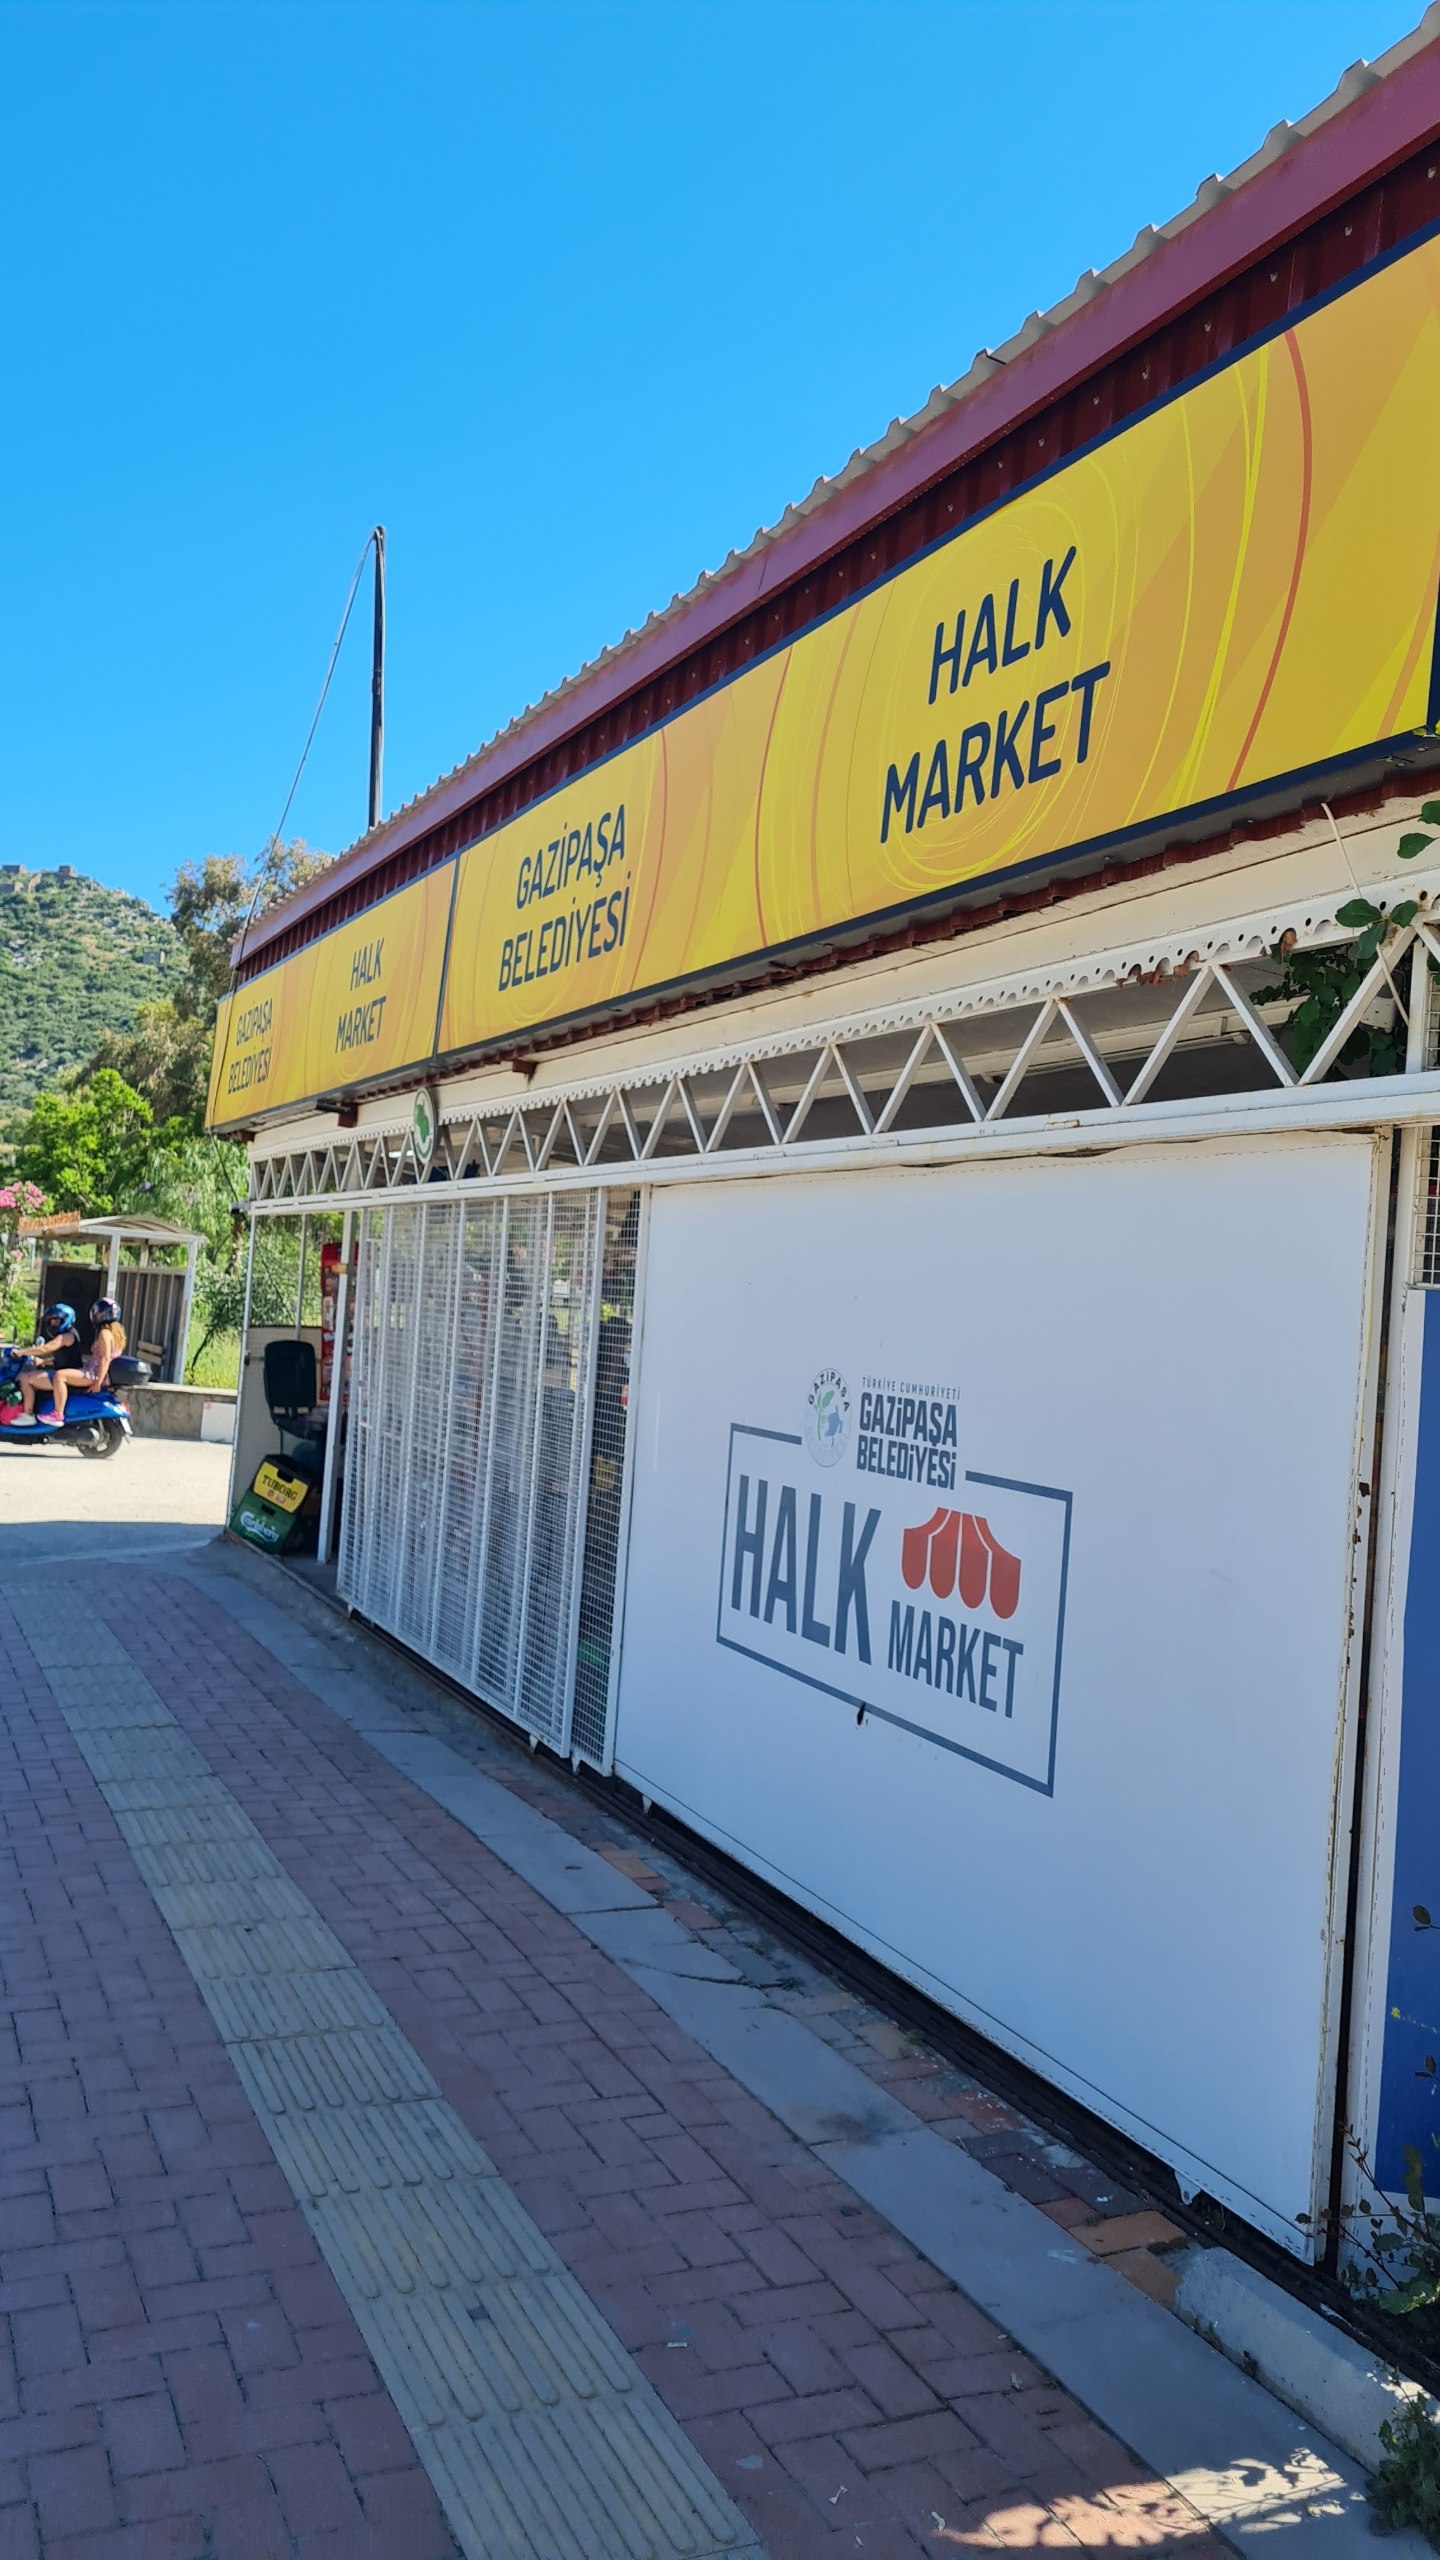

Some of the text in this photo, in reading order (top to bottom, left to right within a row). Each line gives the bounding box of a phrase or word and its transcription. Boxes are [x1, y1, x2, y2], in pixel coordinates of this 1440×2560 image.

[928, 545, 1077, 705] HALK
[880, 660, 1110, 844] MARKET
[516, 803, 626, 910] GAZİPAŞA
[498, 870, 632, 992] BELEDİYESİ
[350, 936, 386, 991] HALK
[236, 998, 273, 1046] GAZİPAŞA
[335, 996, 387, 1054] MARKET
[228, 1038, 273, 1095] BELEDİYESİ
[862, 1375, 961, 1400] TÜRKİYE CUMHURİYETİ
[859, 1392, 957, 1448] GAZİPAŞA
[262, 1474, 298, 1500] TUBORG
[857, 1434, 957, 1490] BELEDİYESİ
[731, 1474, 882, 1665] HALK
[887, 1600, 1024, 1719] MARKET
